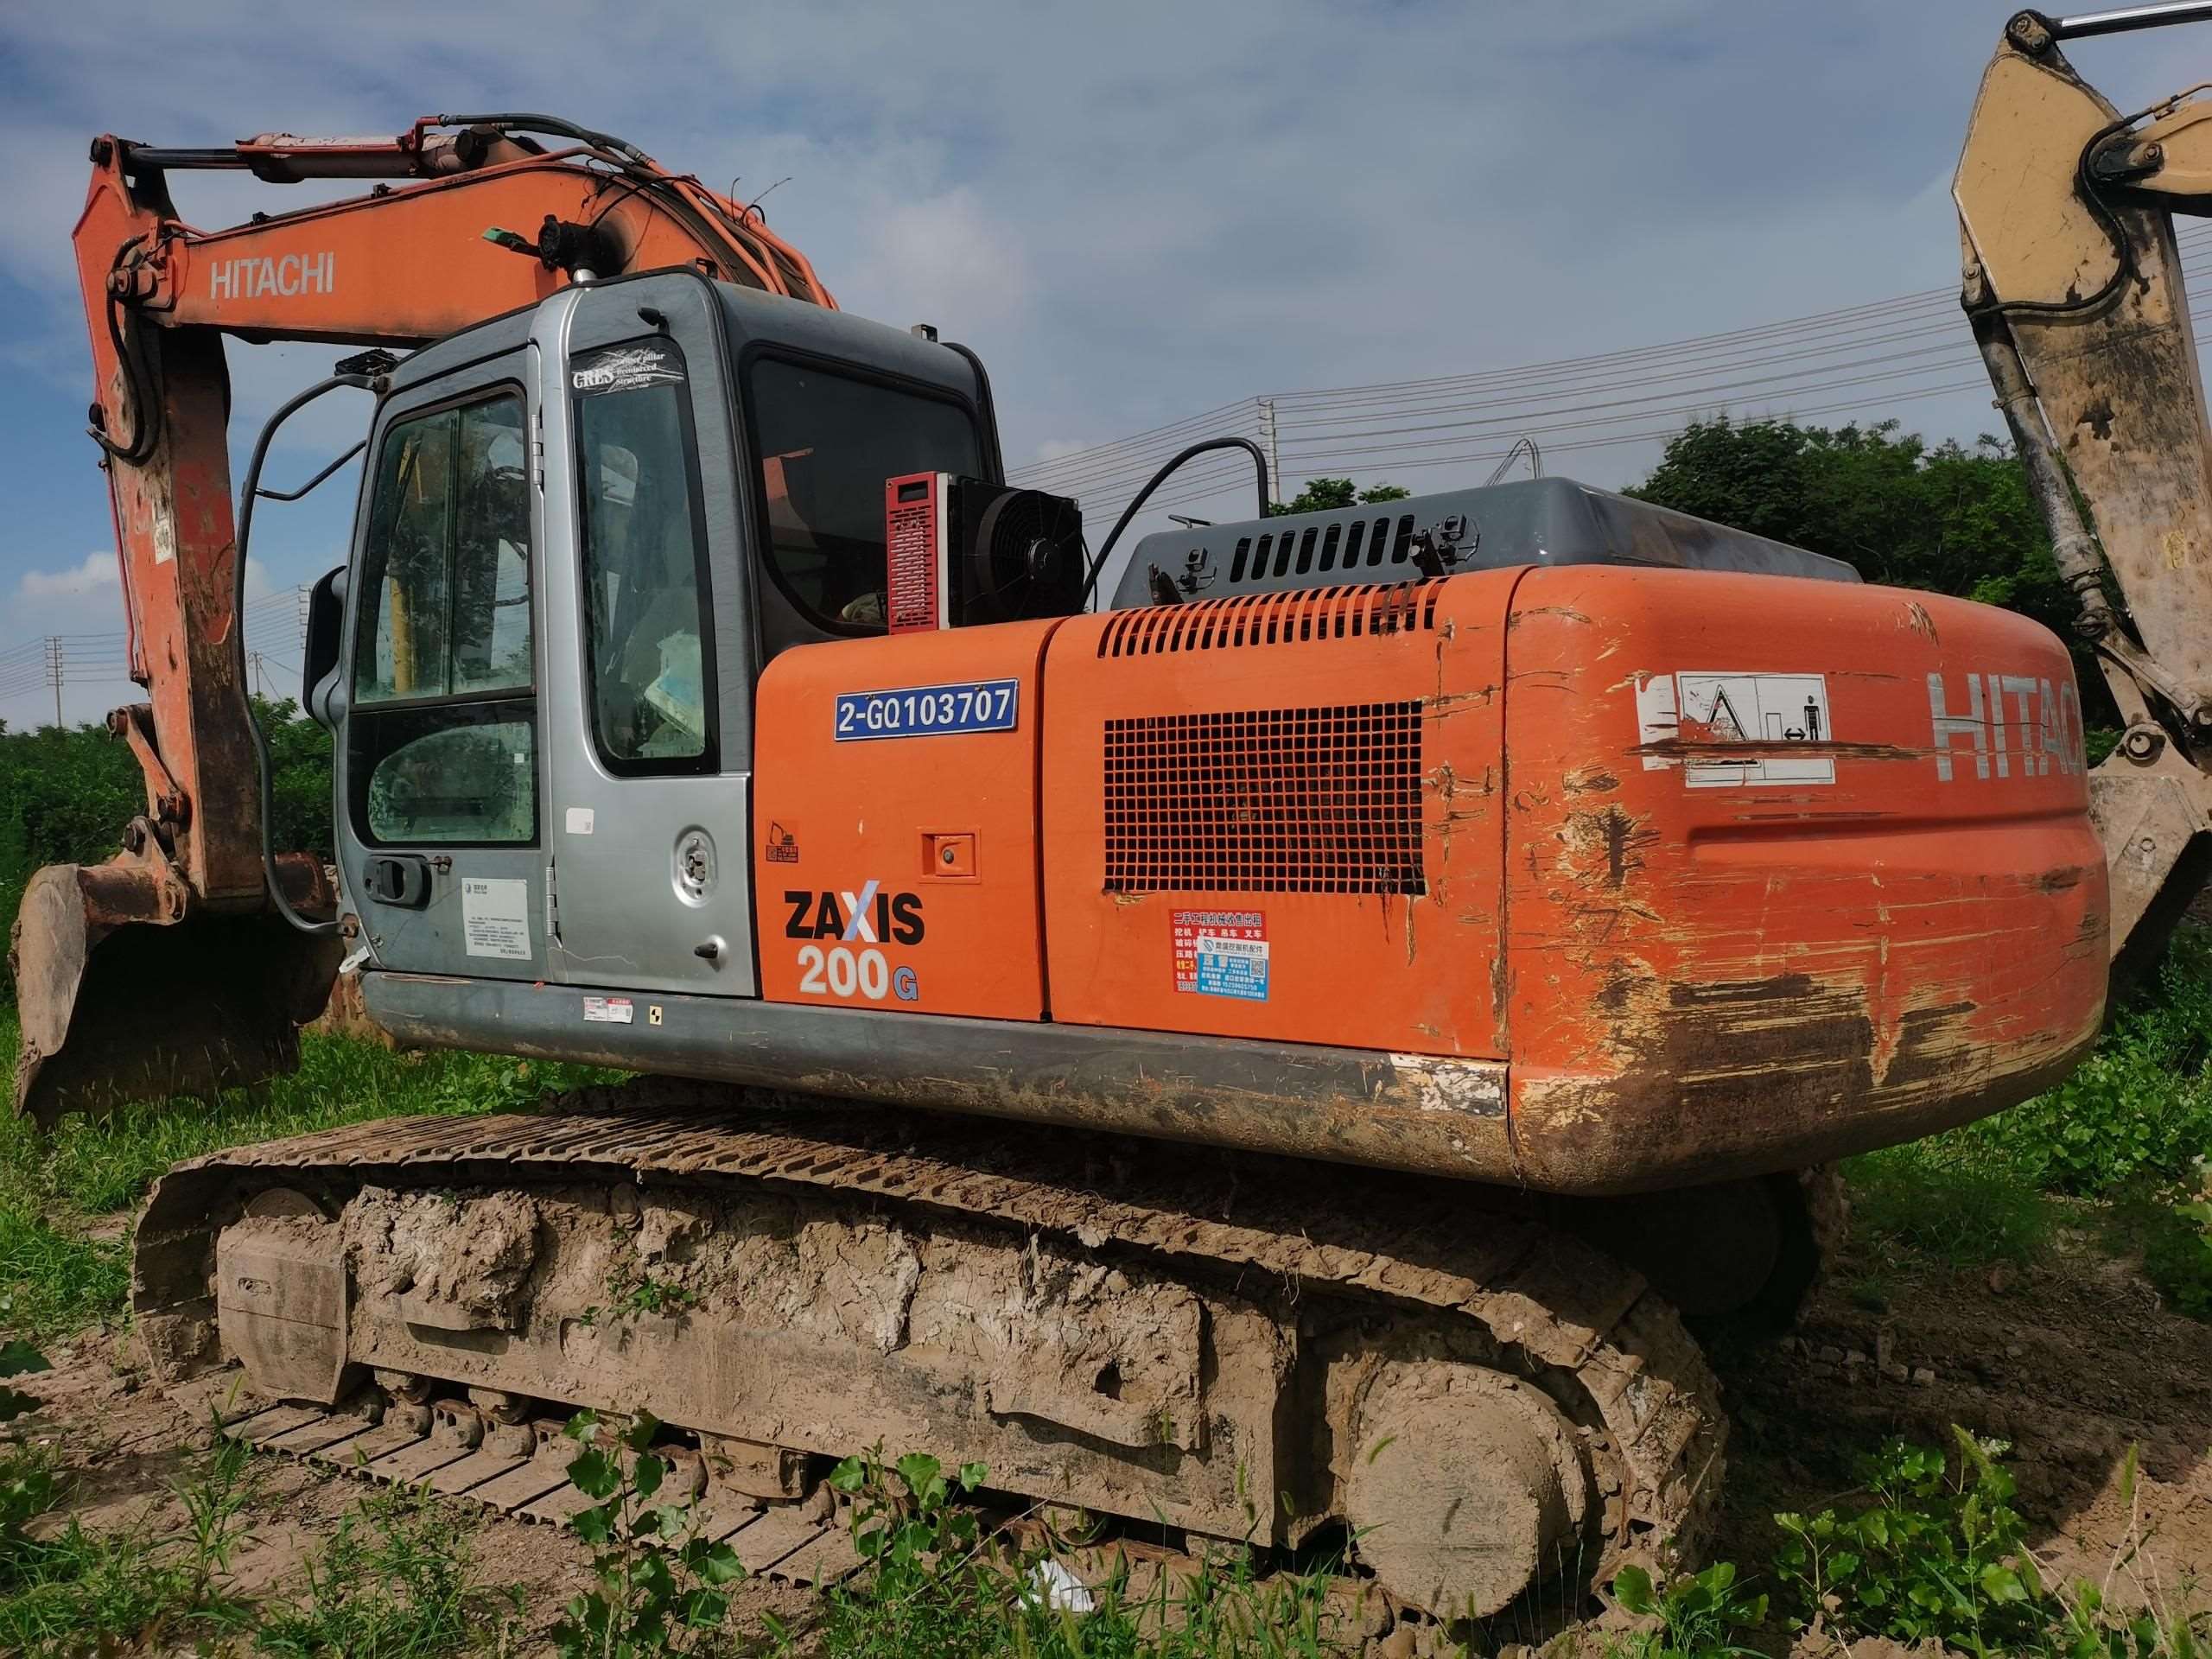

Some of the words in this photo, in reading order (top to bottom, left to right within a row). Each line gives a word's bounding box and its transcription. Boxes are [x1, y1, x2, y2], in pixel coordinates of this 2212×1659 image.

[210, 251, 334, 299] HITACHI
[839, 689, 1011, 732] 2-GQ103707
[785, 880, 925, 945] ZAXIS
